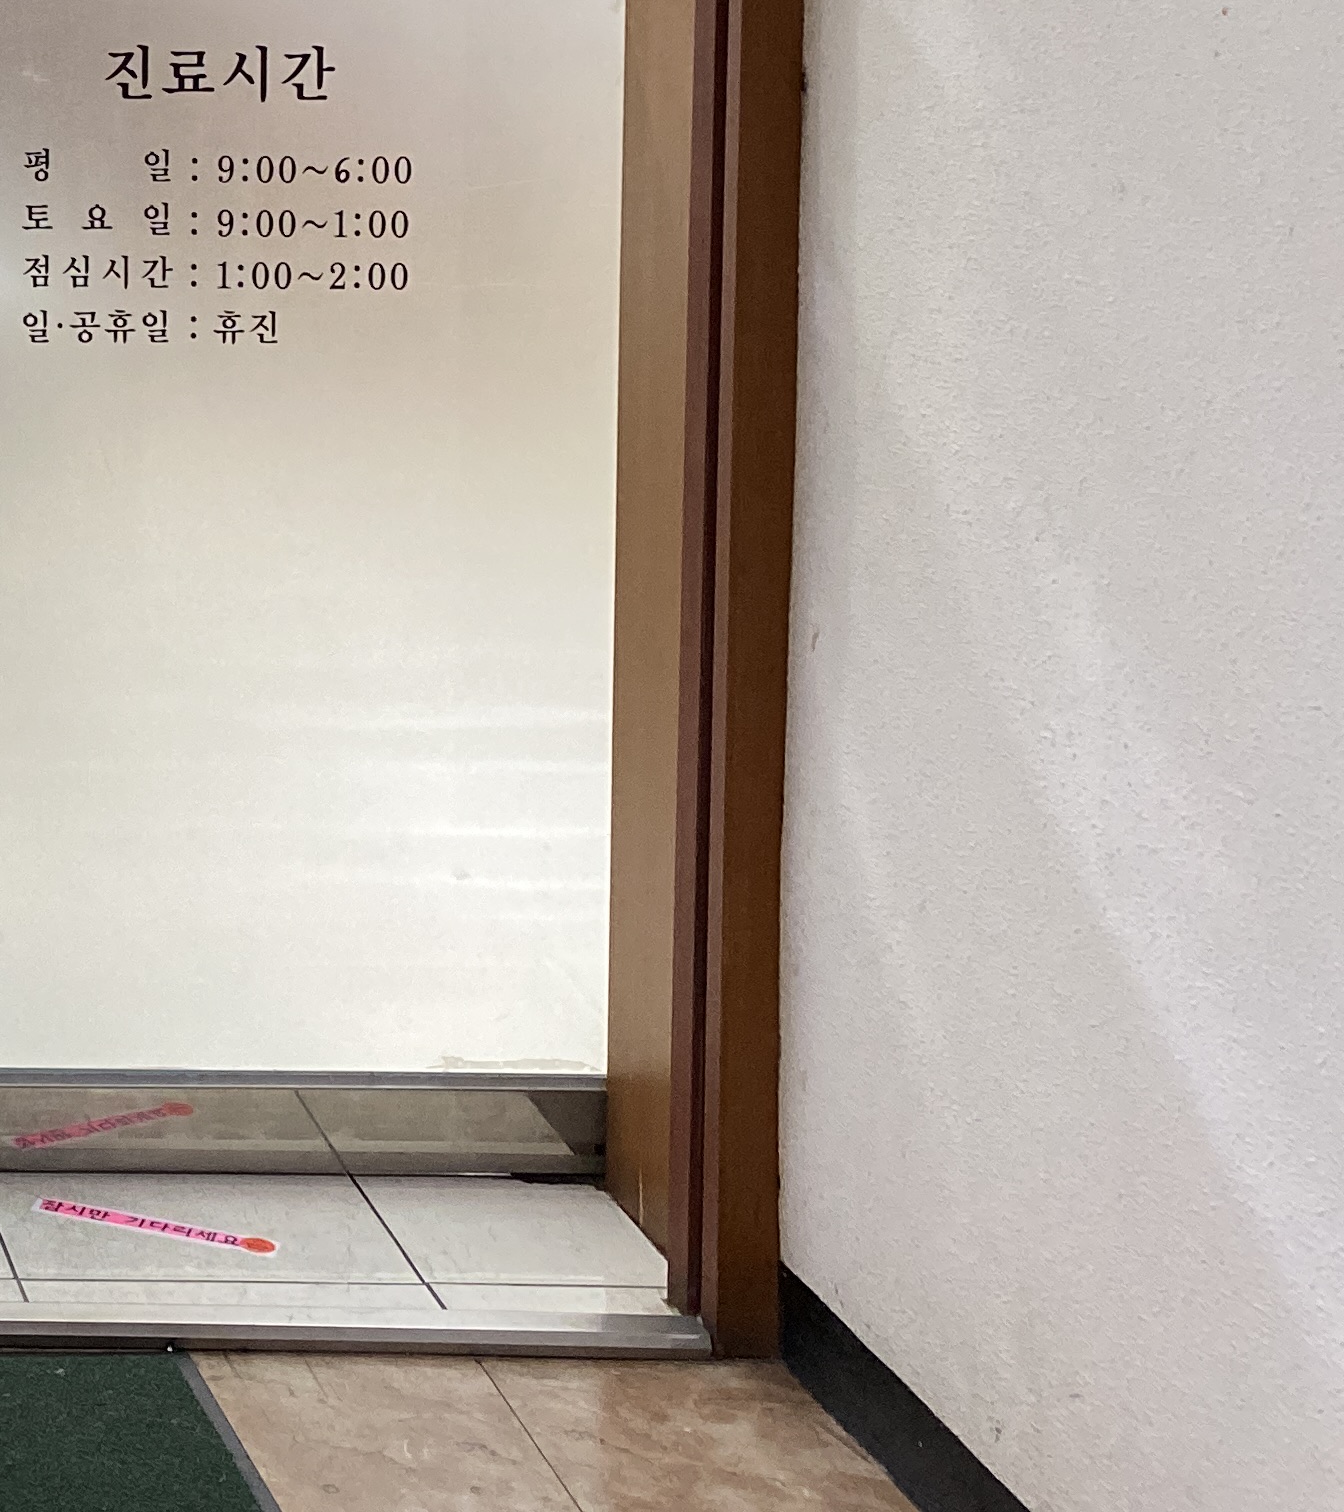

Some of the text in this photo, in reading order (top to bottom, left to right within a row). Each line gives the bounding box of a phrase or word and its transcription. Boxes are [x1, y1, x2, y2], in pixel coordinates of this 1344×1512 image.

[103, 43, 336, 104] 진료시간
[212, 308, 280, 346] 휴진
[41, 1198, 241, 1248] 잠시만 기다리세요
